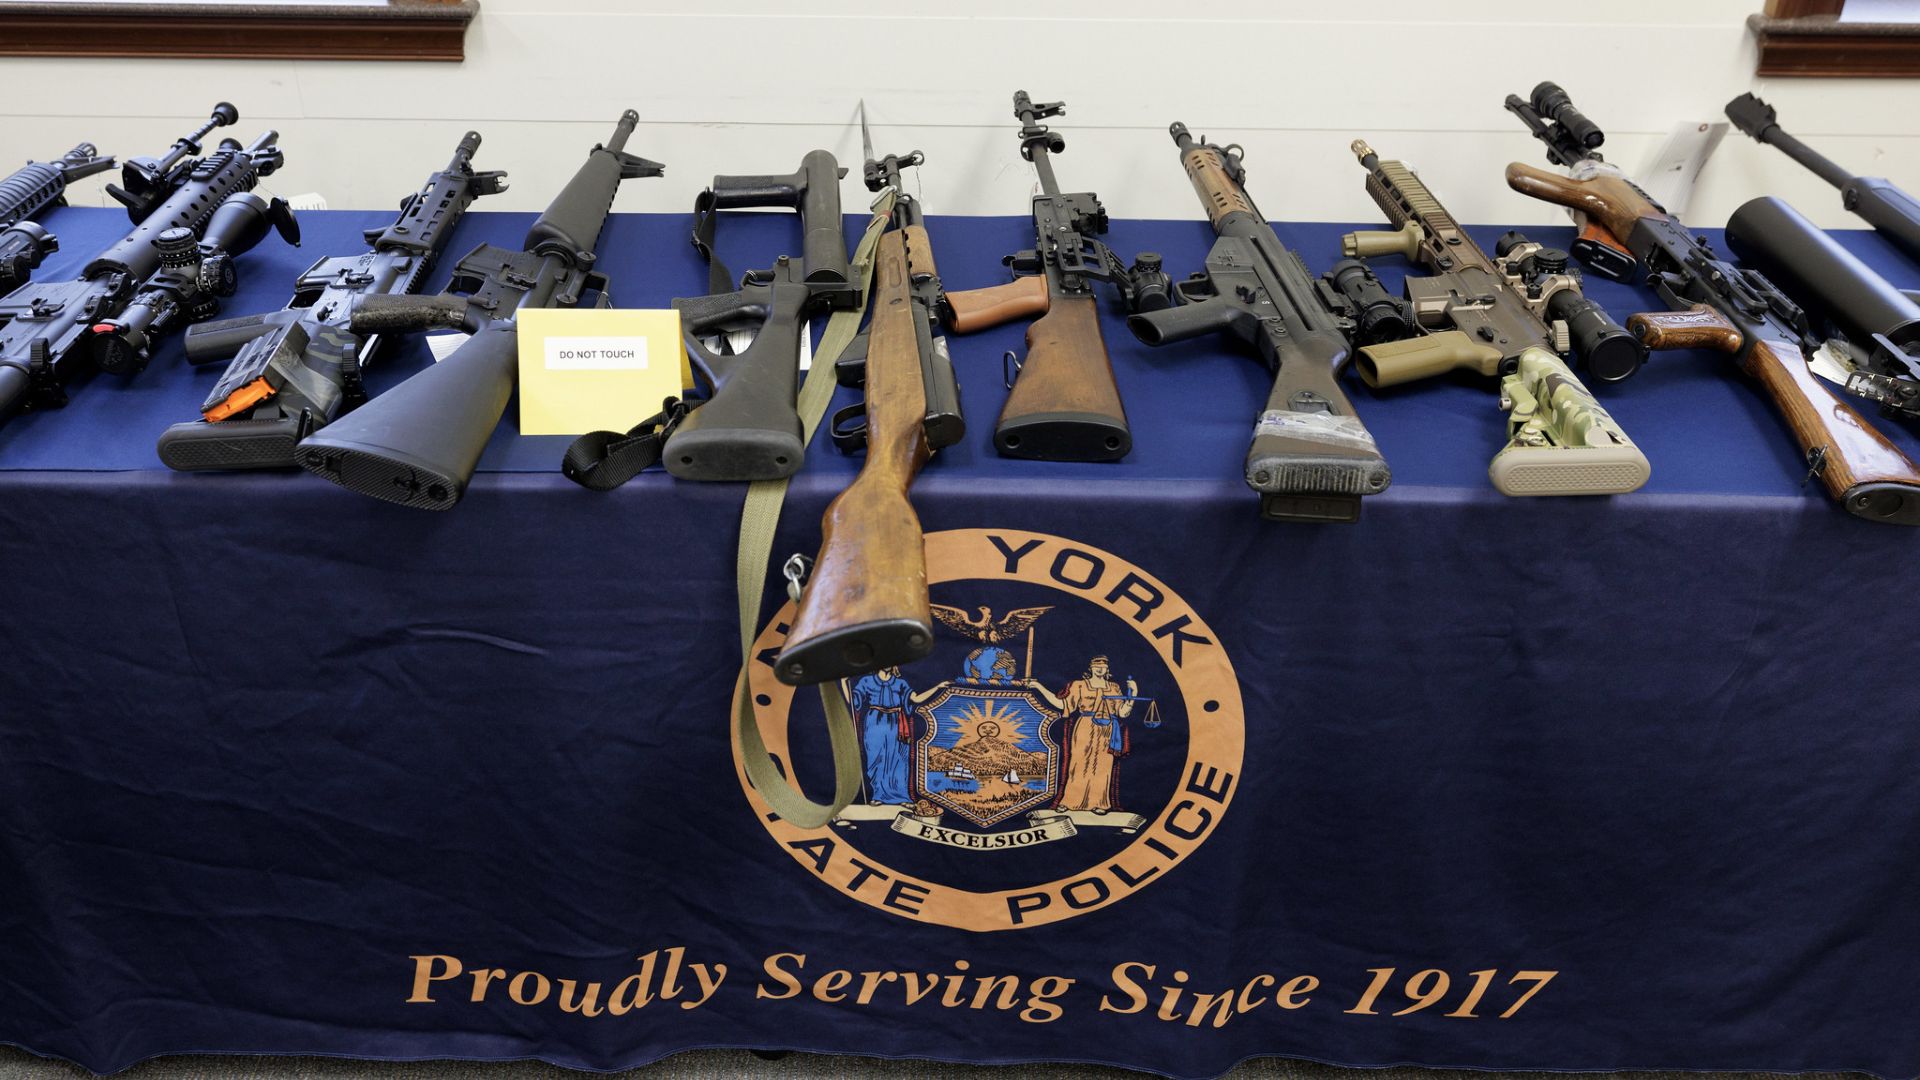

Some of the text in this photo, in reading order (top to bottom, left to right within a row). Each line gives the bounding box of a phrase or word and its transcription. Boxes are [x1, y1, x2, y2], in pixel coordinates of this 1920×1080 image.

[559, 350, 635, 359] DO NOT TOUCH
[986, 534, 1213, 669] YORK
[918, 824, 1050, 849] EXCELSIOR
[1006, 761, 1234, 925] POLICE
[406, 946, 1559, 1028] Proudly Serving Since 1917
